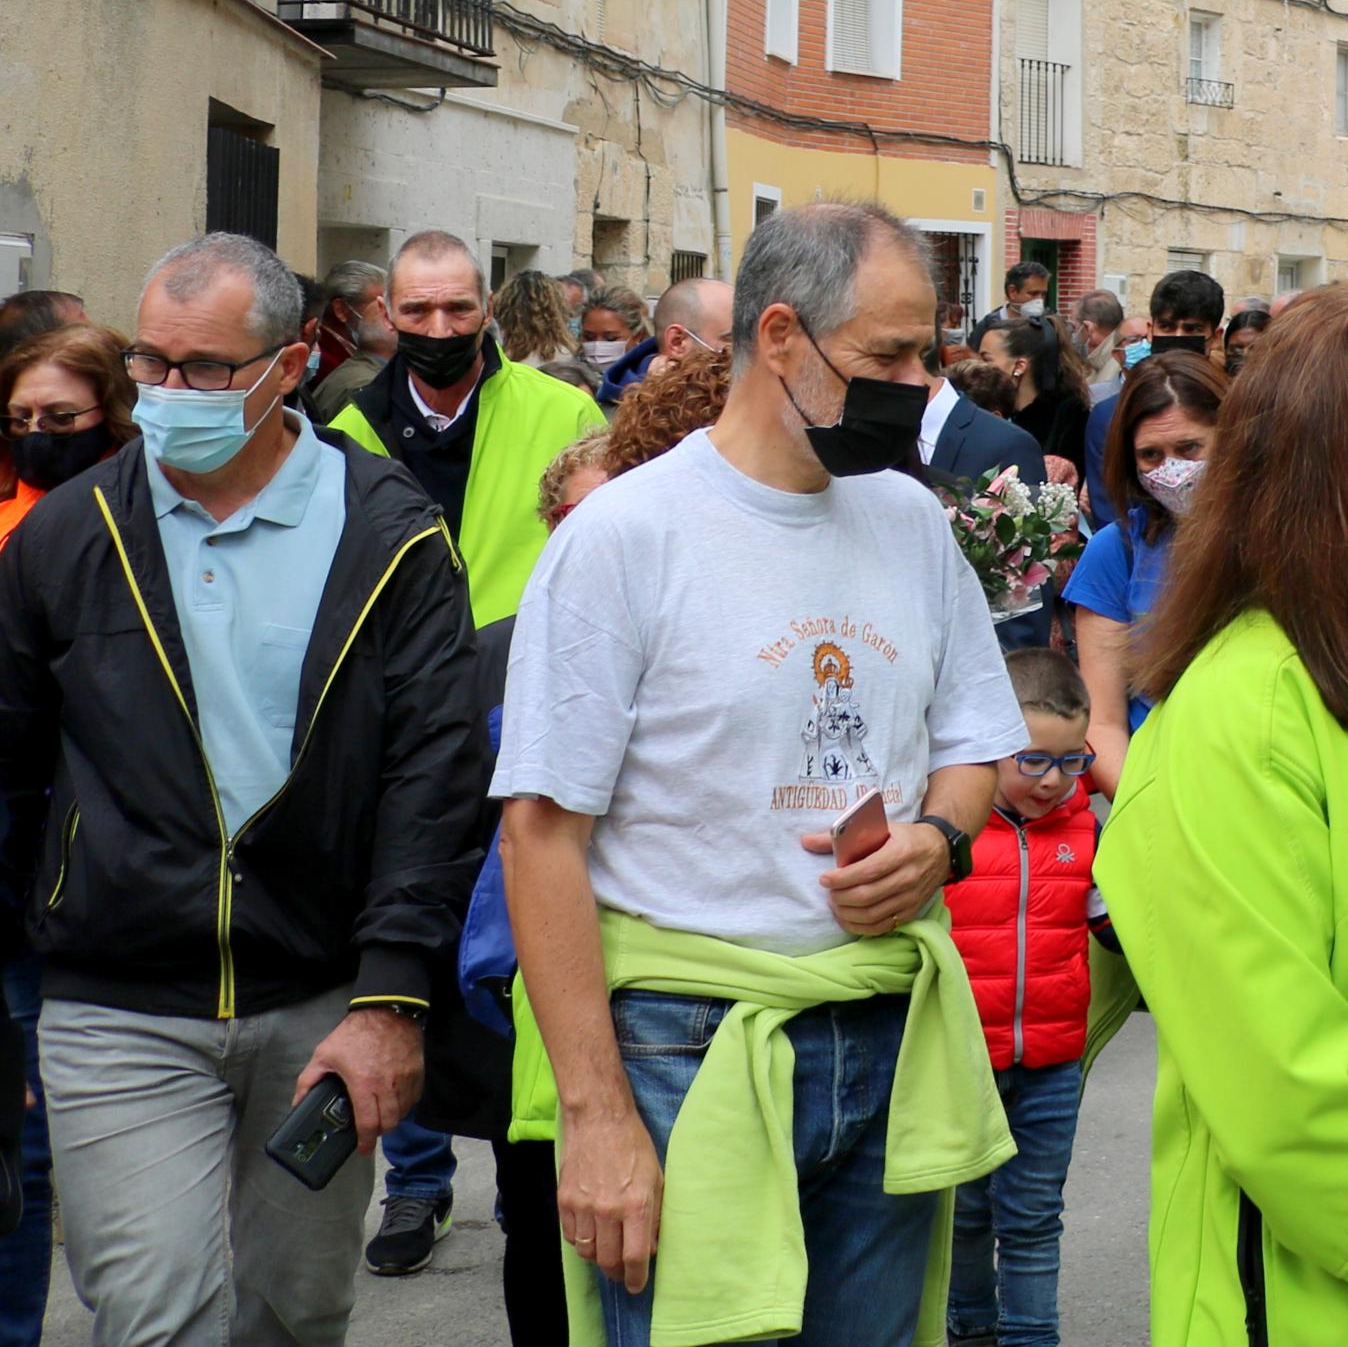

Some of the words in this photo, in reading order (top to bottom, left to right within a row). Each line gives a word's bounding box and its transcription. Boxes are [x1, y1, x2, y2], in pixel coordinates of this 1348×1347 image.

[757, 635, 796, 669] Ntra
[789, 615, 837, 640] Señora
[841, 614, 857, 639] de
[862, 622, 900, 664] Garón
[770, 781, 848, 811] ANTIGÜEDAD
